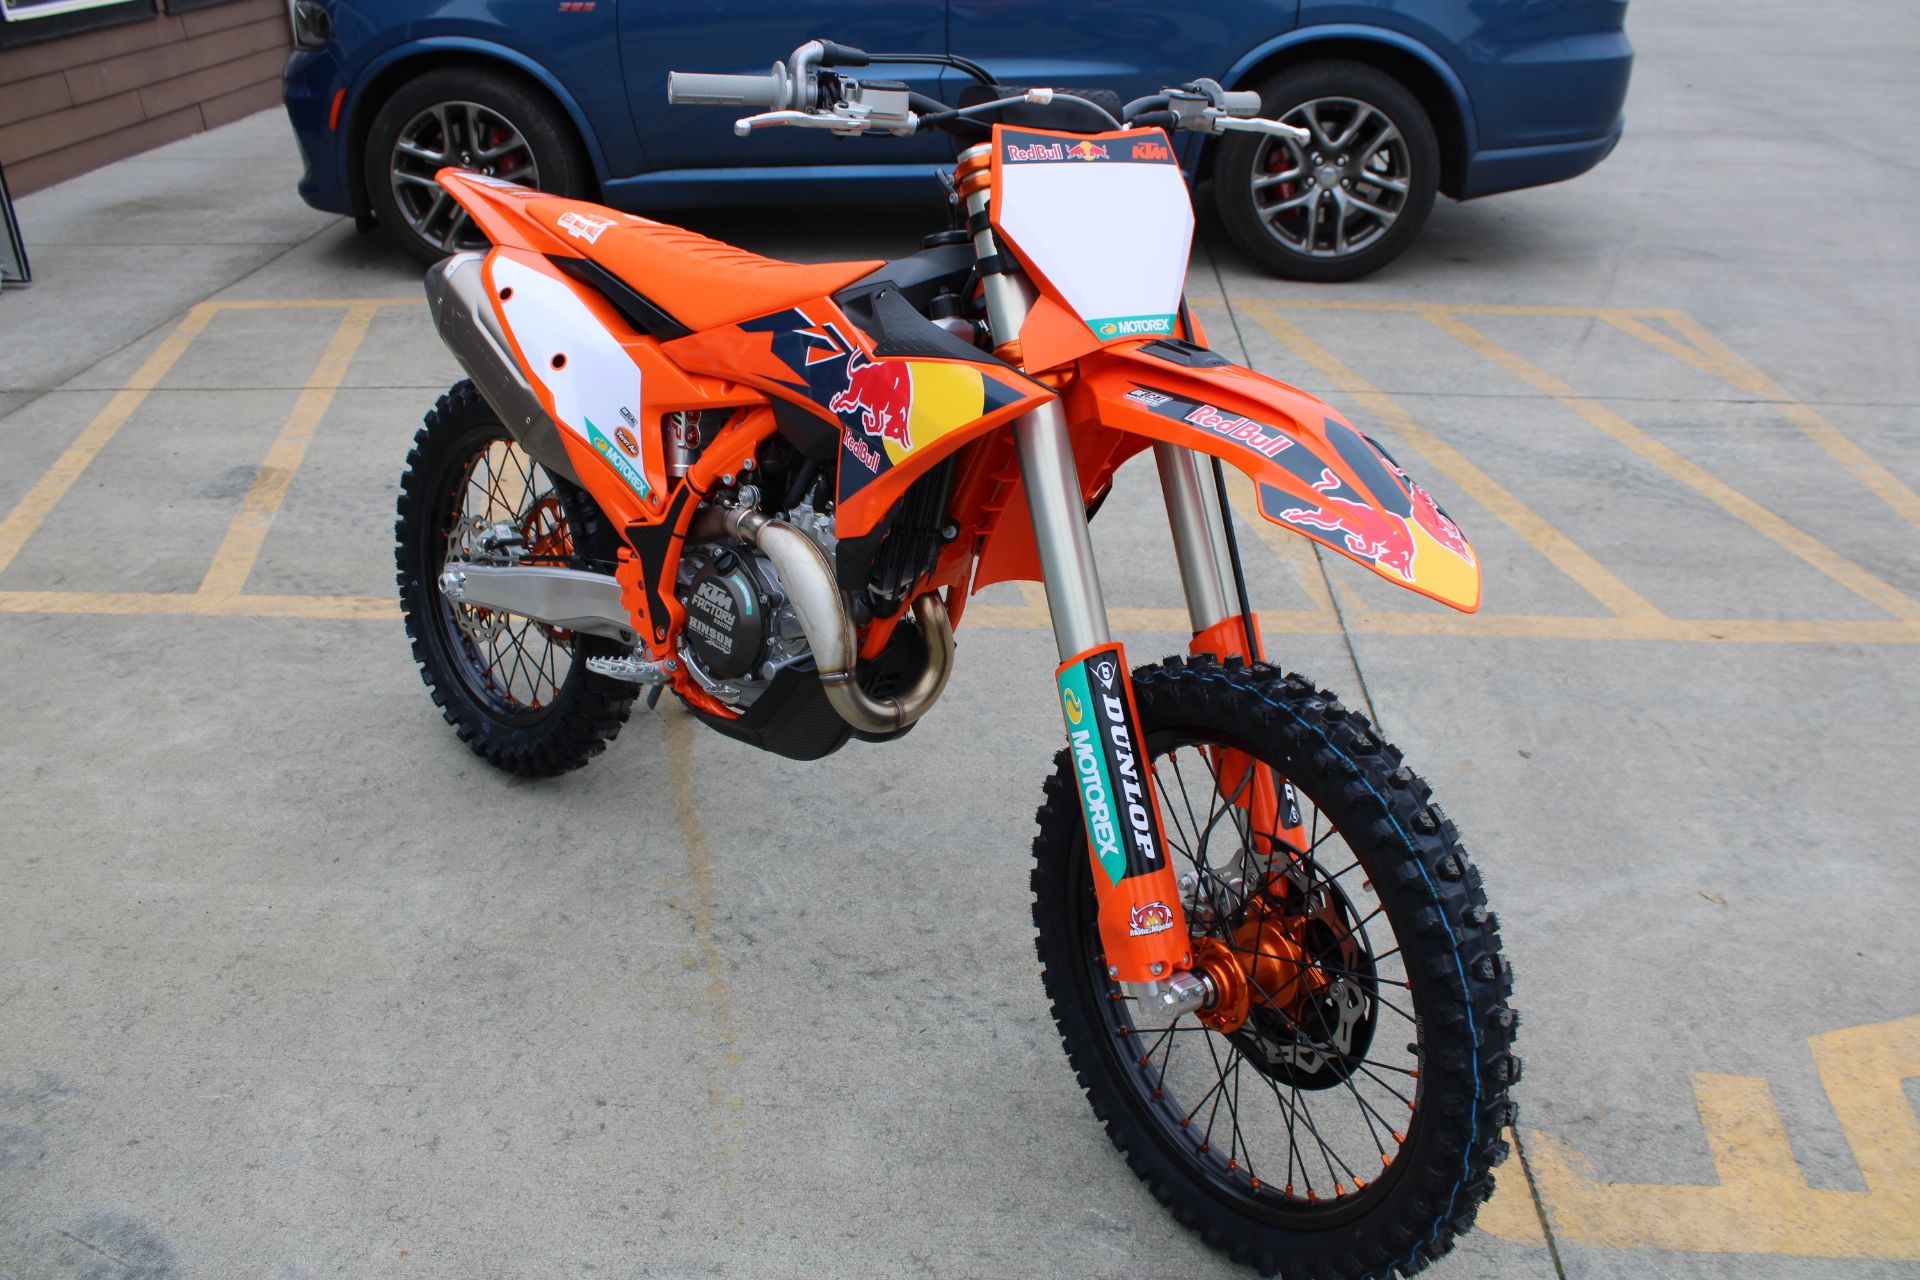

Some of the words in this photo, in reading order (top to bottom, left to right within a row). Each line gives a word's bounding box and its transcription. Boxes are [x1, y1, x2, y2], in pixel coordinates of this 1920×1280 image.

[1131, 142, 1168, 160] KTM
[1118, 319, 1169, 334] MOTOREX
[606, 447, 646, 495] MOTOREX
[692, 594, 736, 626] FACTORY
[697, 582, 733, 611] KTM
[689, 616, 733, 649] HINSON
[1103, 693, 1156, 860] DUNLOP
[1072, 729, 1119, 859] MOTOREX
